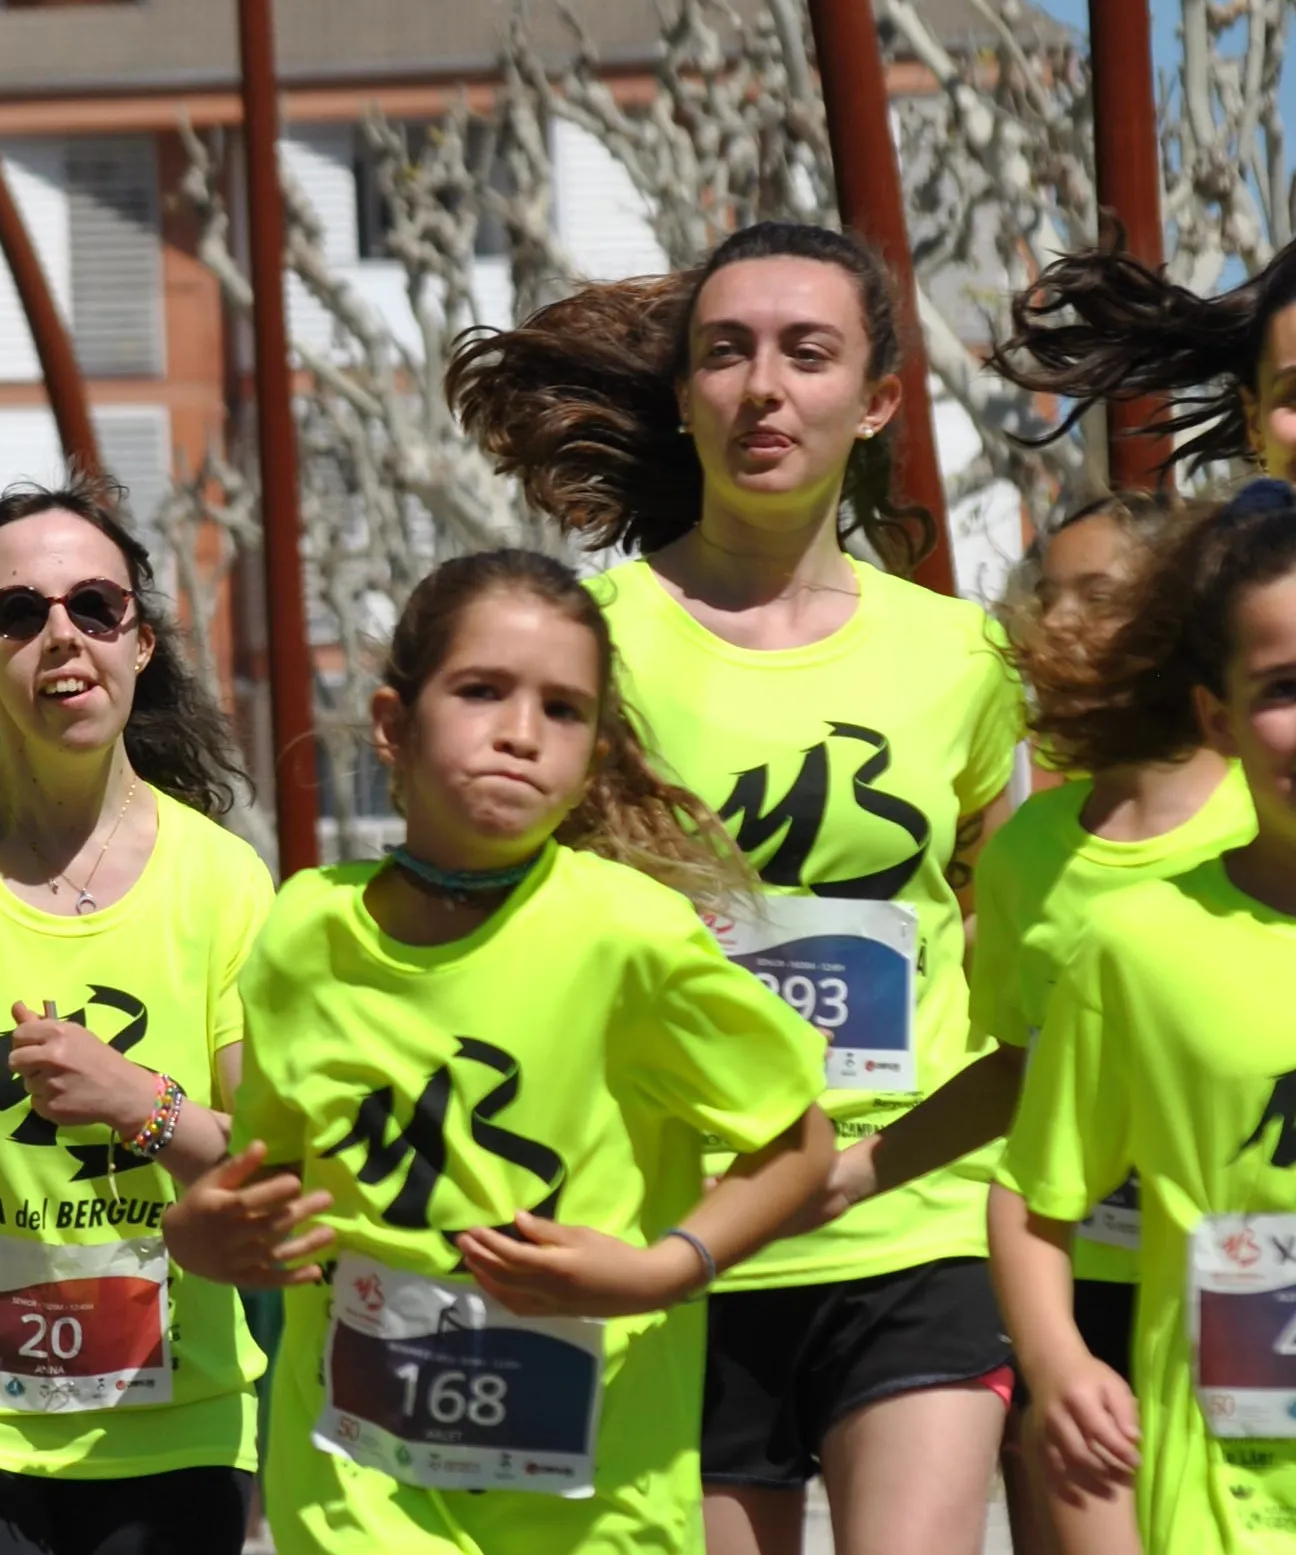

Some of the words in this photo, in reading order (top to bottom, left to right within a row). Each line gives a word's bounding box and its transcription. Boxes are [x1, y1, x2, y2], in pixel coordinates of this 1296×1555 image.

[15, 1198, 48, 1231] del
[55, 1198, 174, 1230] BERGUE
[18, 1312, 83, 1360] 20
[394, 1364, 509, 1427] 168
